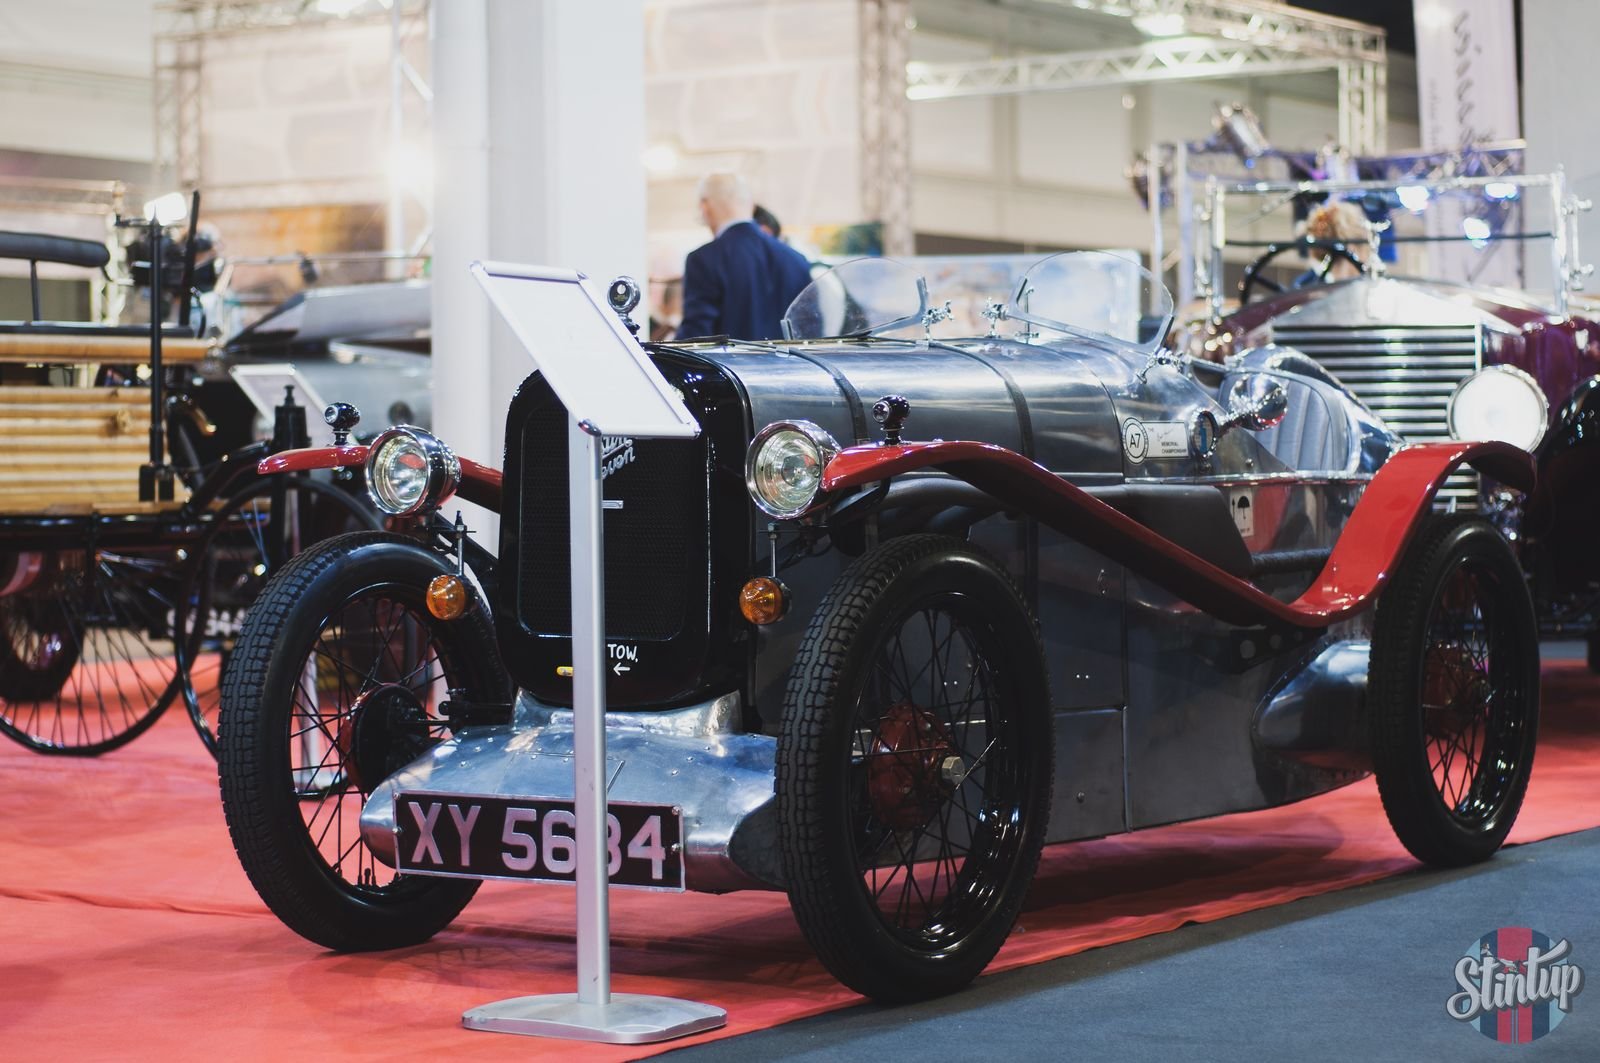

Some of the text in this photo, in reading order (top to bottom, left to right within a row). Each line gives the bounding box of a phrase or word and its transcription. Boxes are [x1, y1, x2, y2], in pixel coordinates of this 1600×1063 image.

[1129, 432, 1141, 449] A7
[601, 446, 635, 480] even
[408, 801, 482, 867] XY
